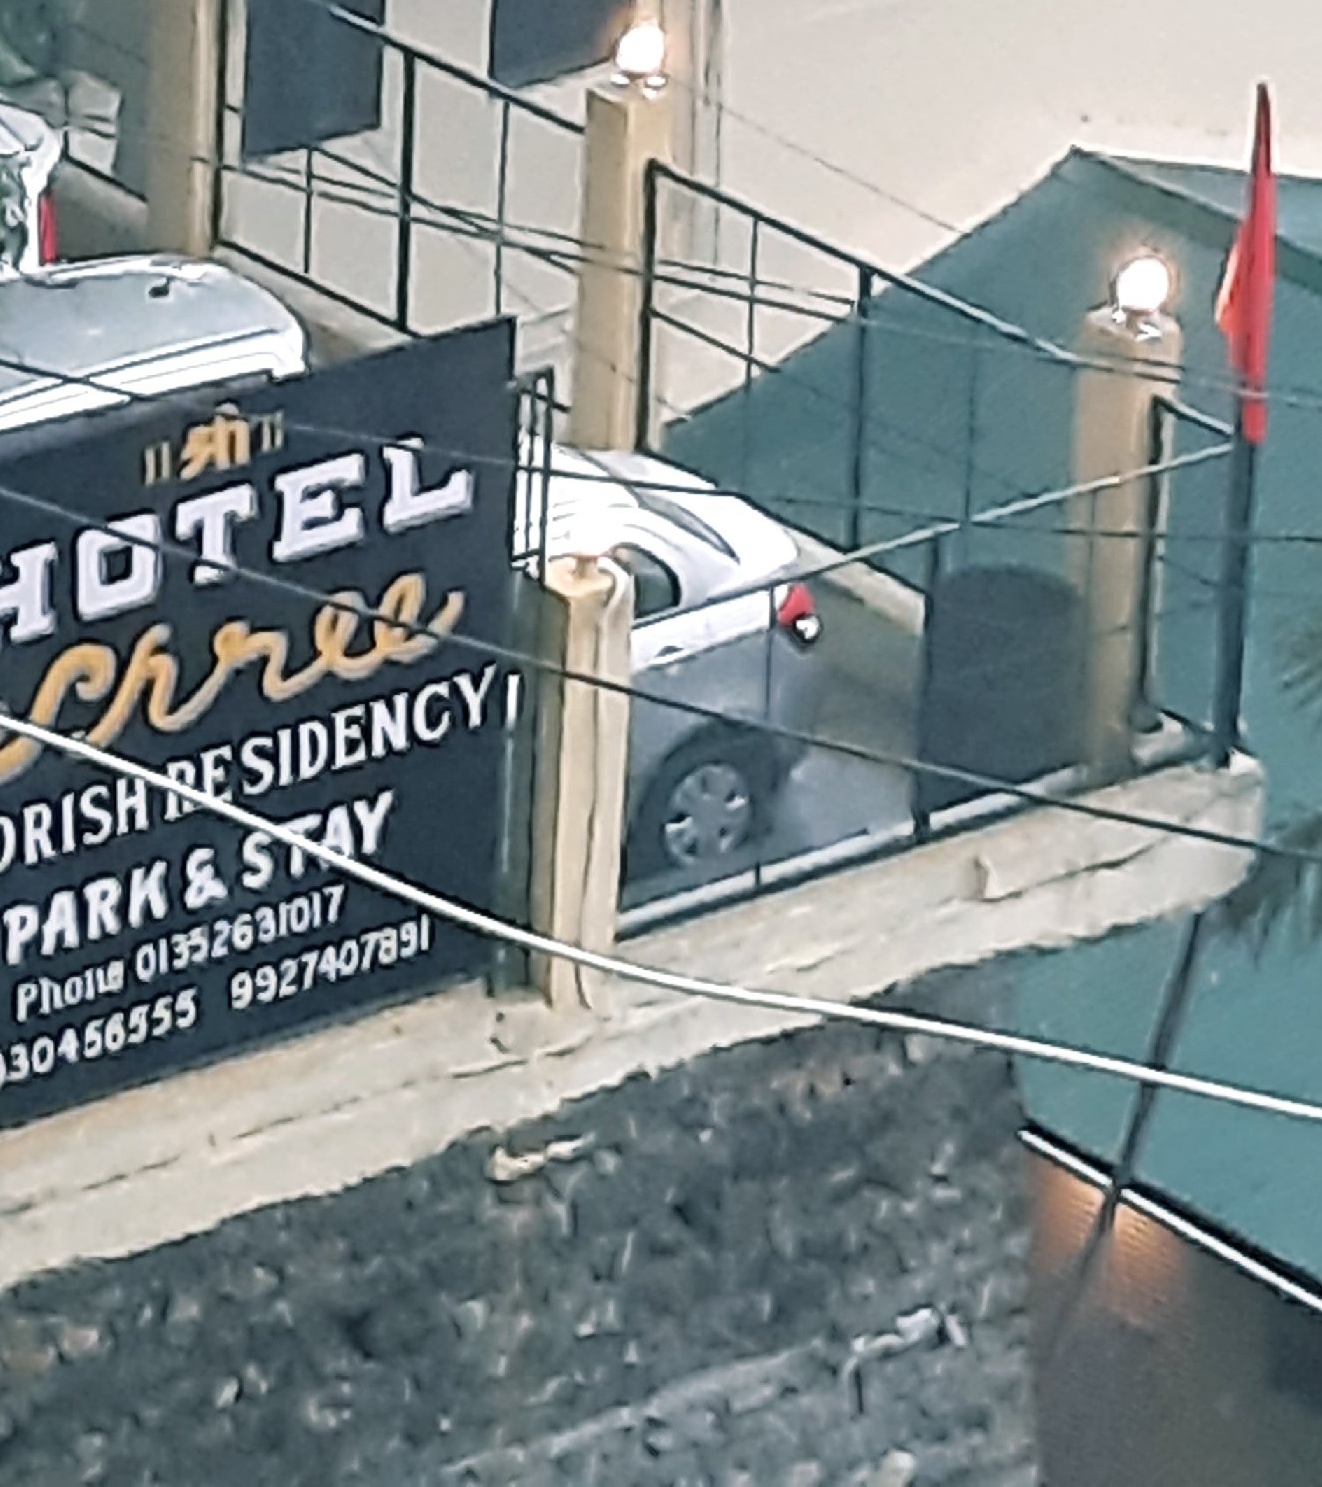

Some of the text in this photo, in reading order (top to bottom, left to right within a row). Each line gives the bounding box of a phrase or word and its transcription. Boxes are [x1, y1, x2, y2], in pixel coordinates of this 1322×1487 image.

[164, 664, 498, 821] RESIDENCY
[2, 791, 396, 966] PARK & STAY
[16, 960, 124, 1022] Phone
